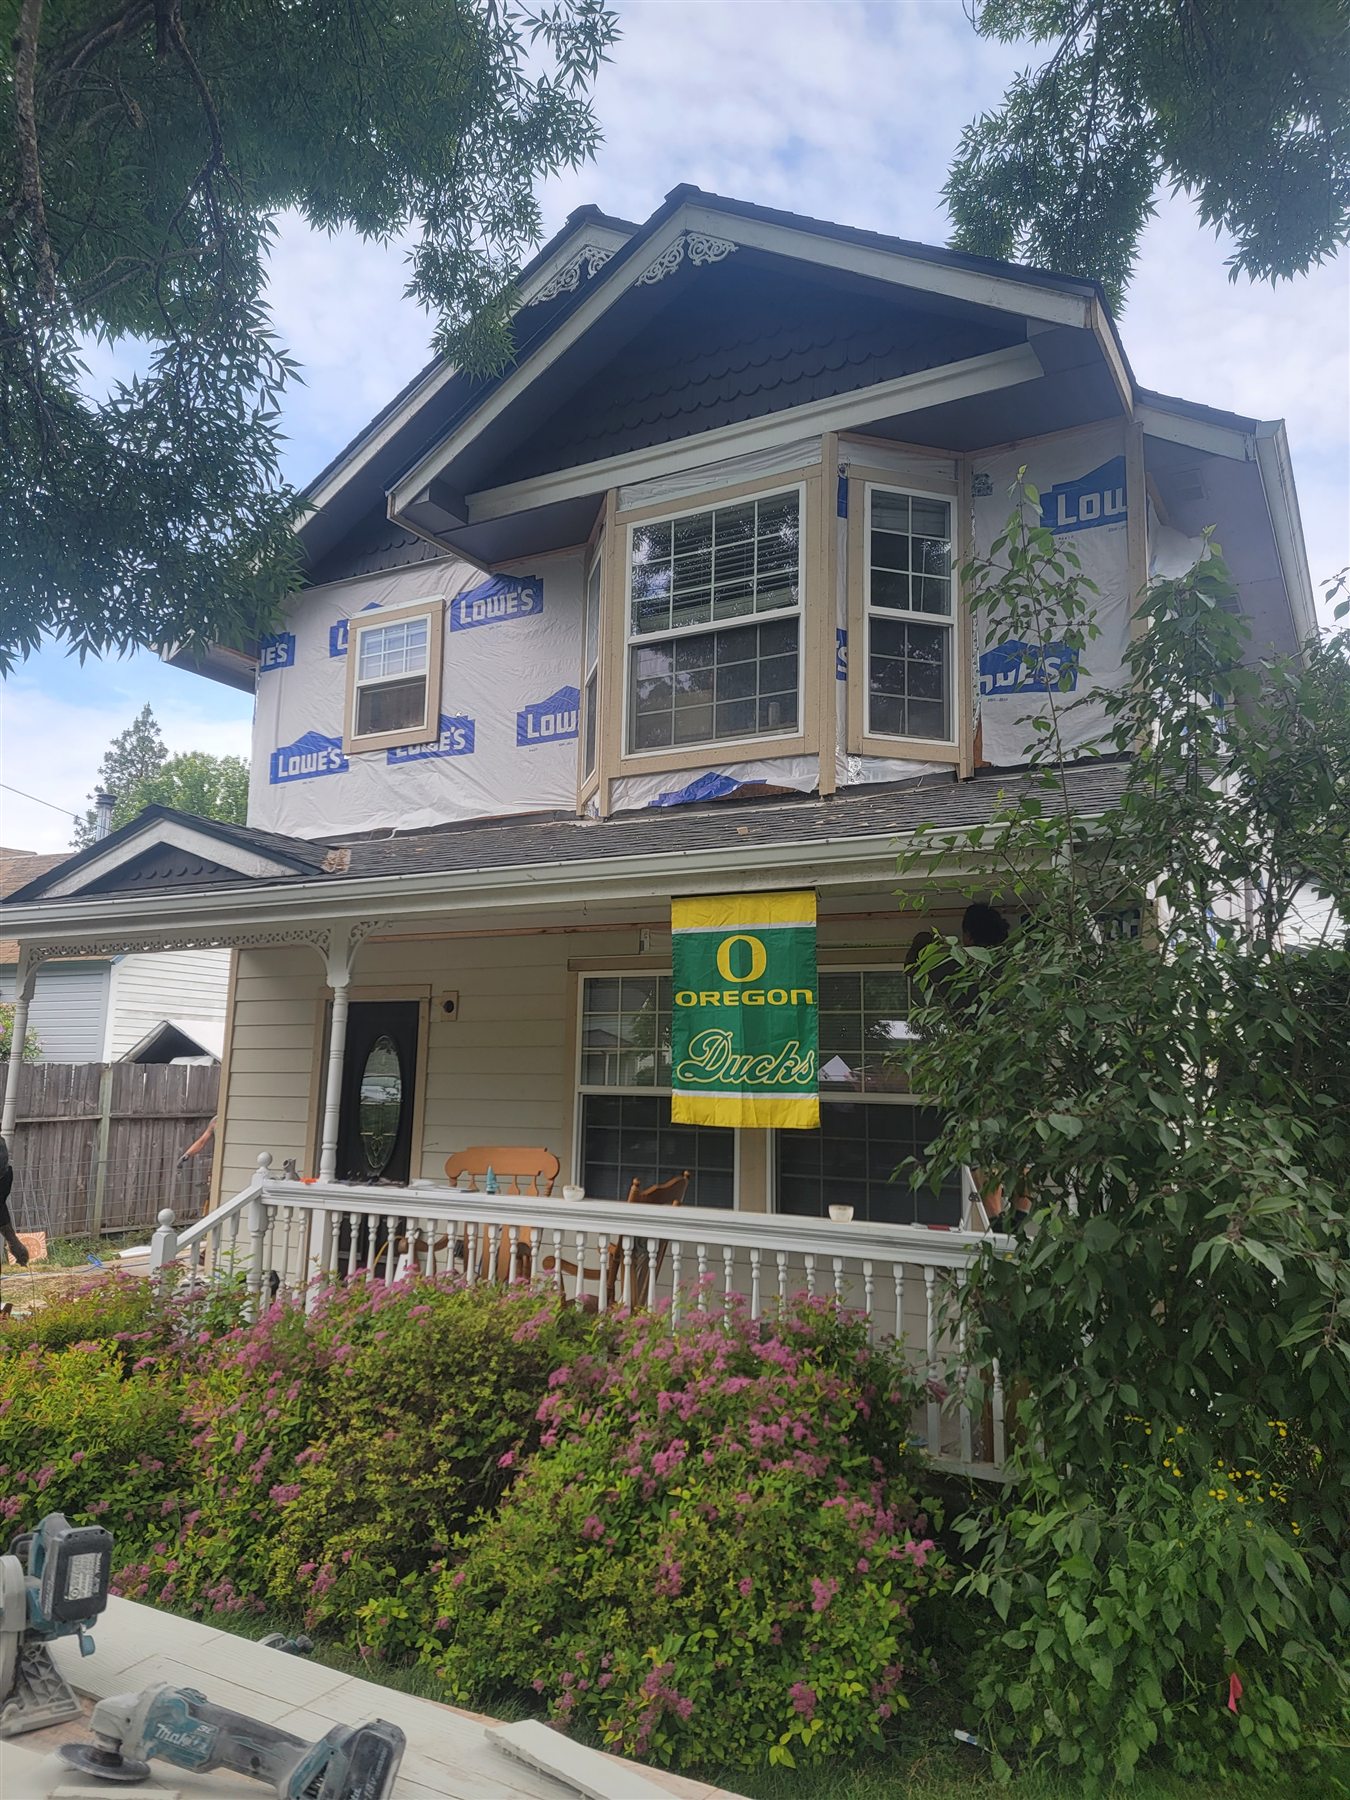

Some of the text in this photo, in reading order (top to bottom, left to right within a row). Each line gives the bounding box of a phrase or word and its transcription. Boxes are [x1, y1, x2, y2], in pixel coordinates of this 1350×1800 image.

[460, 586, 533, 624] LOWE'S
[260, 642, 288, 667] E'S
[527, 709, 580, 739] LOW
[278, 746, 341, 777] LOWE'S
[716, 934, 767, 983] O
[674, 988, 814, 1007] OREGON
[676, 1028, 816, 1085] Ducks
